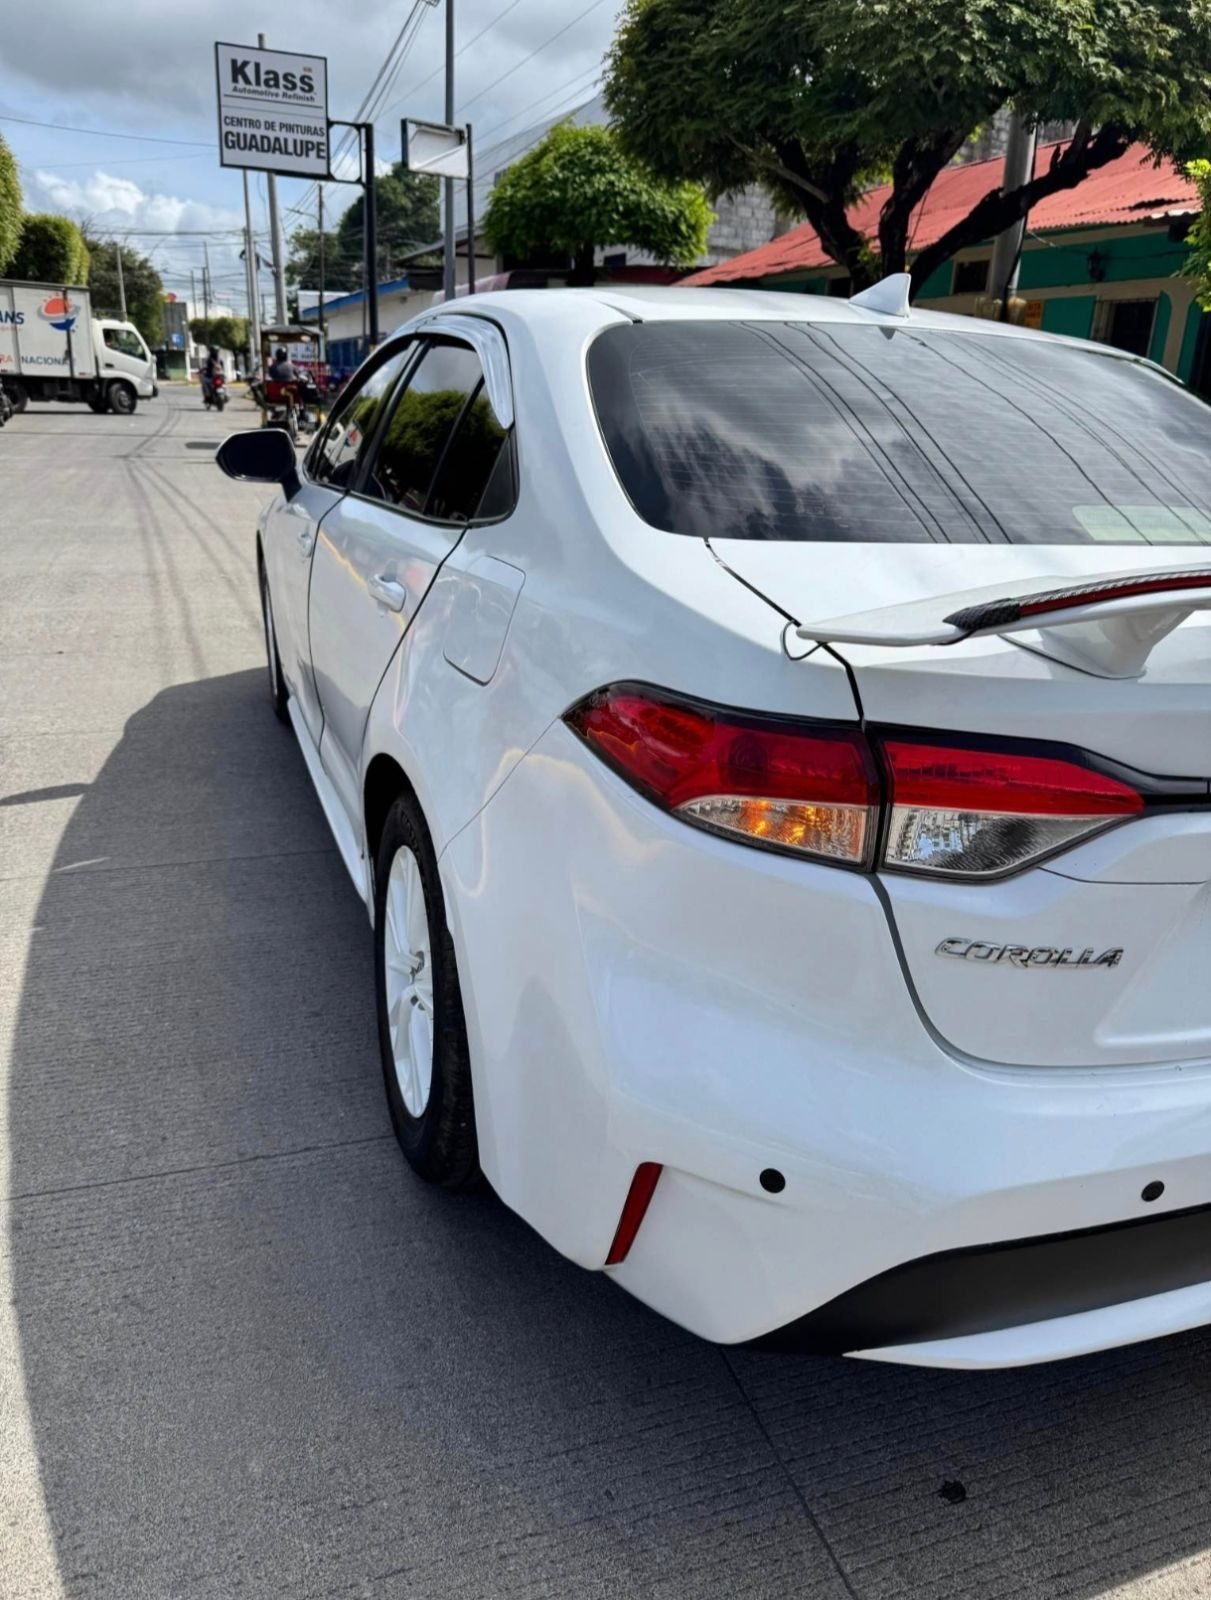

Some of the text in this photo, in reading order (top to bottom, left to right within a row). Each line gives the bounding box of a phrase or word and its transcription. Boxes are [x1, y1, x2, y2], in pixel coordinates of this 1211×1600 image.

[230, 58, 314, 93] Klass
[232, 85, 315, 102] Automotive Refinish
[224, 116, 325, 137] CENTRO DE PINTURAS
[224, 130, 326, 160] GUADALUPE
[21, 356, 75, 366] NACIONA
[934, 937, 1124, 969] COROLLA
